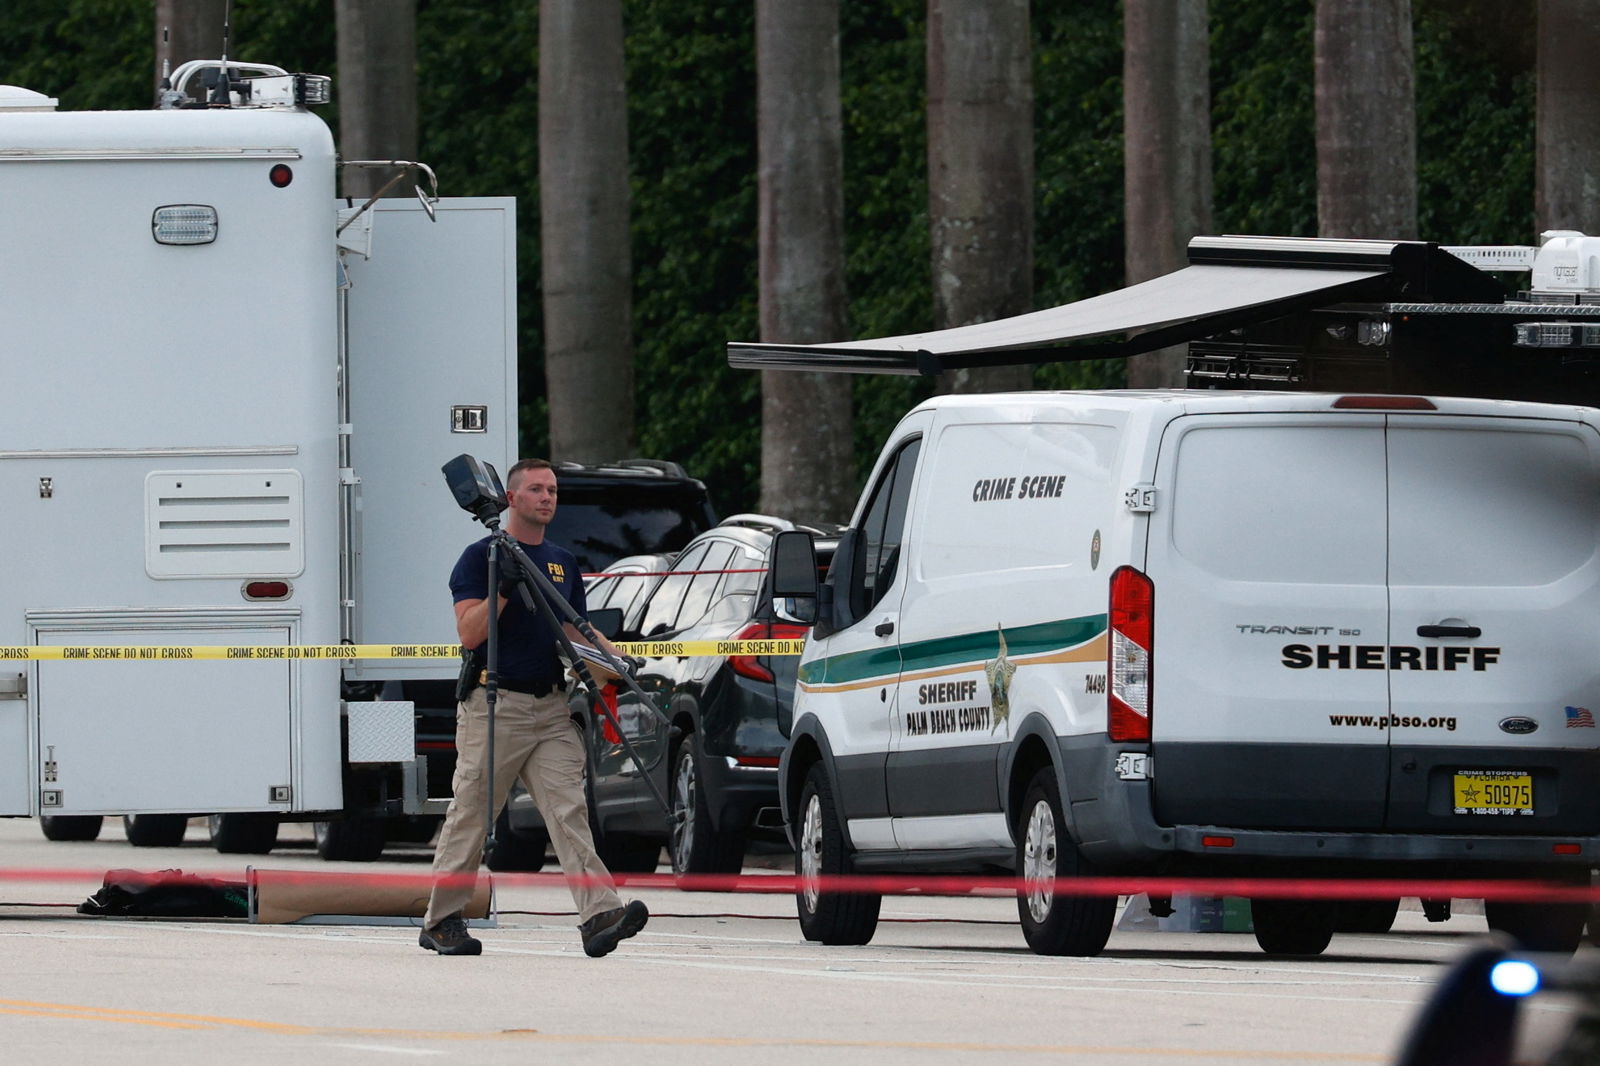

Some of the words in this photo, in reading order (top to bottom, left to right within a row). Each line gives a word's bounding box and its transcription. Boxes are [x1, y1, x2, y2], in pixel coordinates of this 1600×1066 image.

[973, 477, 1016, 502] CRIME
[1018, 475, 1066, 499] SCENE
[547, 562, 565, 576] FBI
[1236, 624, 1334, 636] TRANSIT
[1339, 628, 1361, 637] 150
[63, 647, 90, 659] CRIME
[93, 647, 121, 659] SCENE
[124, 647, 136, 659] DO
[140, 647, 157, 659] NOT
[161, 647, 193, 659] CROSS
[227, 647, 253, 659] CRIME
[256, 647, 285, 659] SCENE
[287, 647, 300, 659] DO
[303, 647, 321, 658] NOT
[325, 646, 356, 658] CROSS
[391, 646, 417, 657] CRIME
[420, 646, 449, 657] SCENE
[631, 644, 648, 655] NOT
[652, 643, 683, 655] CROSS
[717, 642, 744, 654] CRIME
[747, 641, 775, 654] SCENE
[778, 641, 790, 653] DO
[793, 641, 805, 653] NO
[1281, 644, 1501, 671] SHERIFF
[918, 680, 977, 705] SHERIFF
[906, 711, 928, 736] PALM
[931, 709, 956, 735] BEACH
[958, 706, 990, 731] COUNTY
[1329, 713, 1457, 731] www.pbso.org
[1484, 784, 1529, 806] 50975
